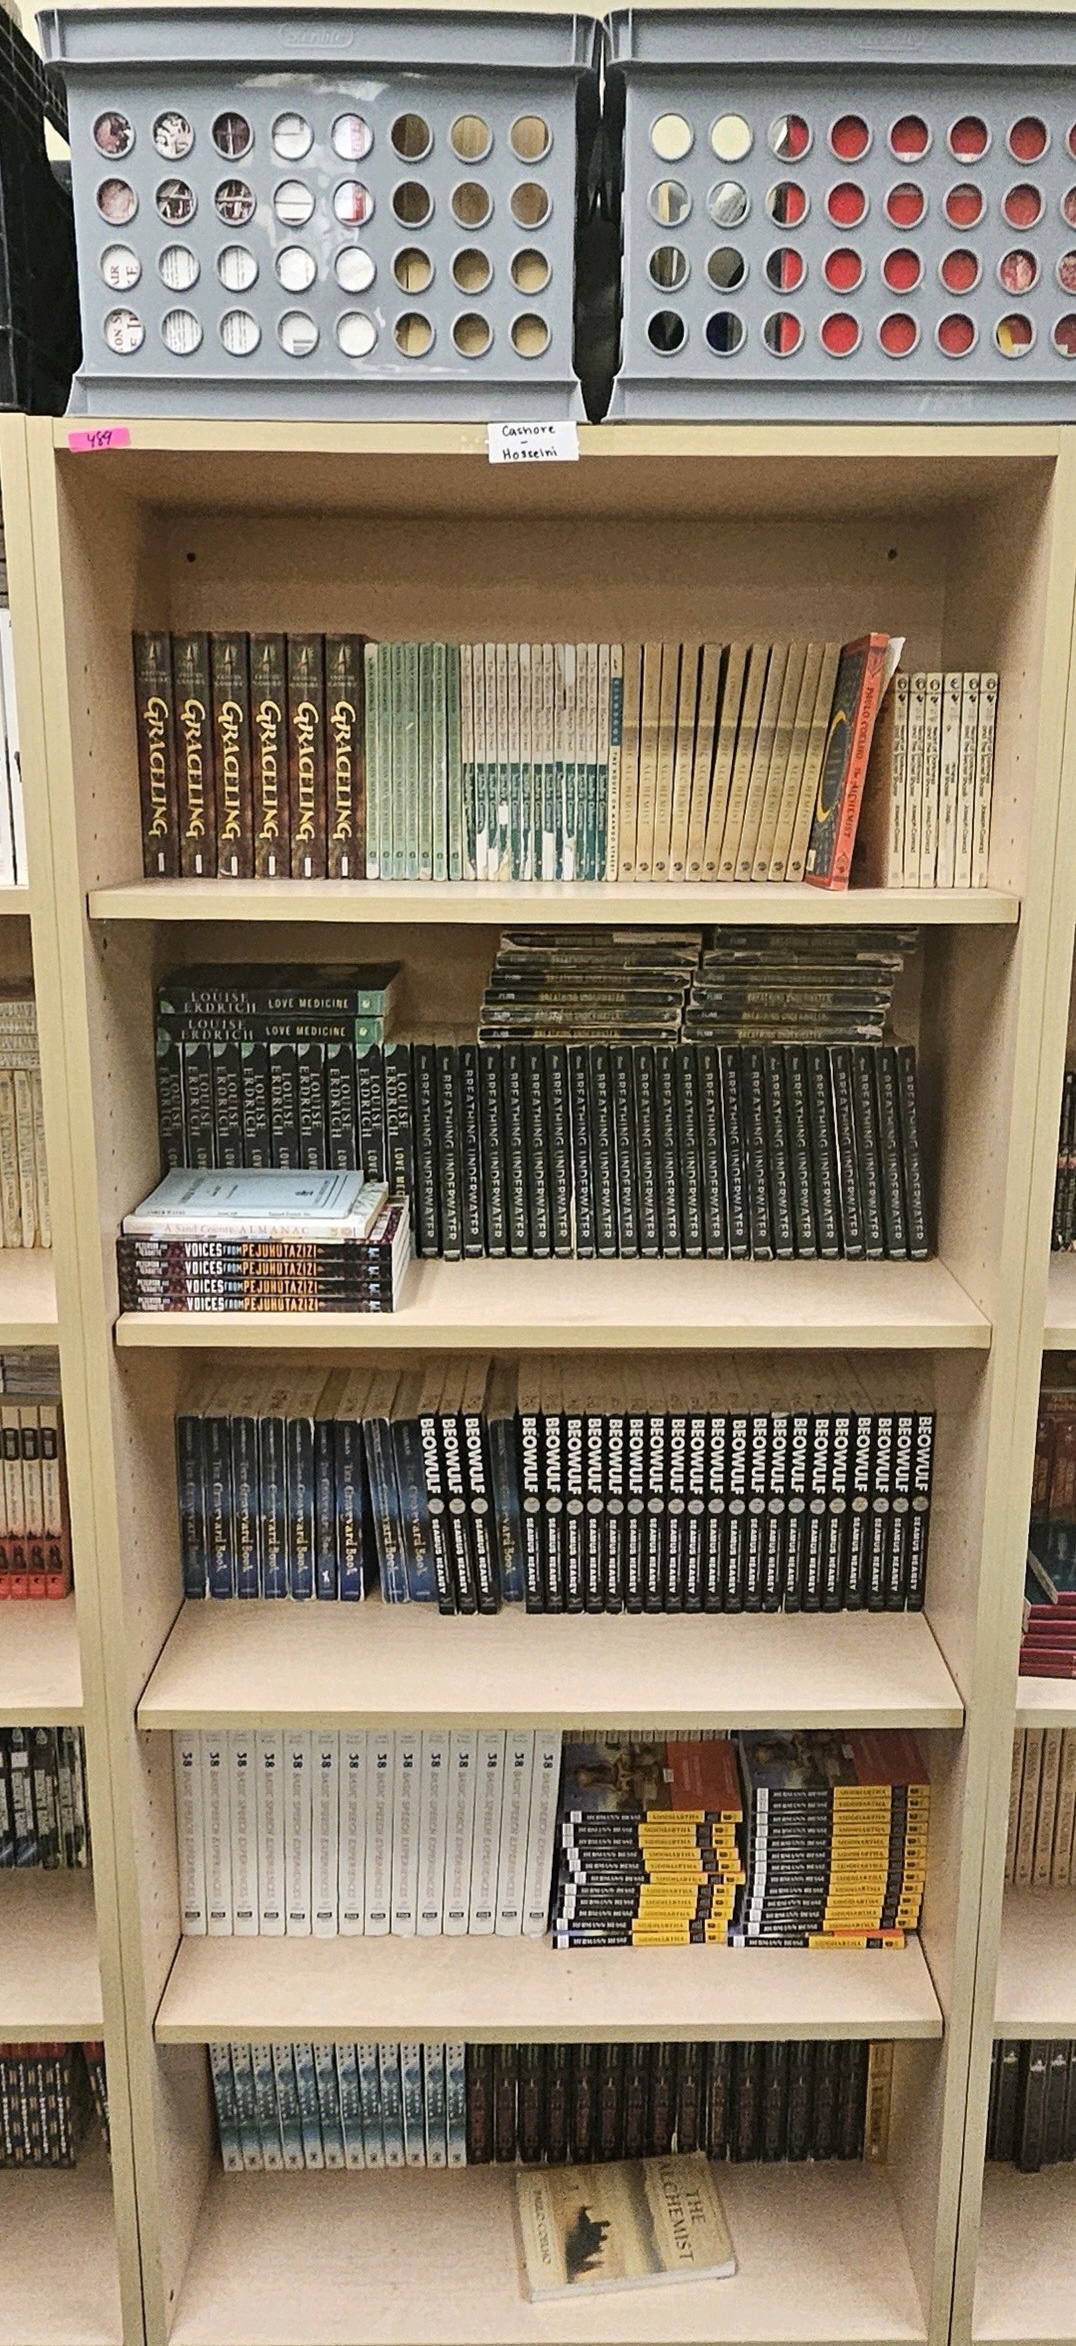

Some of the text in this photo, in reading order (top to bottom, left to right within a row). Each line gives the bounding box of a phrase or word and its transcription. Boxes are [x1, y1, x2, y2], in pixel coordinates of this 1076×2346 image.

[502, 425, 556, 437] Cashore
[144, 697, 168, 838] GRACELING
[181, 699, 205, 838] GRACELING
[218, 701, 243, 841] GRACELING
[256, 701, 281, 841] GRACELING
[293, 702, 319, 841] GRACELING
[331, 701, 356, 841] GRACELING
[181, 1025, 346, 1040] ERDRICH LOVE MEDICINE
[184, 999, 348, 1014] ERDRICH LOVE MEDICINE
[188, 1019, 246, 1030] LOUISE
[191, 992, 248, 1003] LOUISE
[188, 1067, 200, 1136] ERDRICH
[200, 1074, 210, 1128] LOUISE
[217, 1067, 229, 1136] ERDRICH
[228, 1074, 238, 1128] LOUISE
[244, 1068, 256, 1137] ERDRICH
[255, 1075, 266, 1129] LOUISE
[272, 1066, 283, 1136] ERDRICH
[282, 1073, 293, 1128] LOUISE
[300, 1066, 311, 1136] ERDRICH
[310, 1074, 321, 1128] LOUISE
[330, 1069, 341, 1138] ERDRICH
[341, 1075, 351, 1130] LOUISE
[360, 1069, 377, 1173] ERDRICH LOVE
[370, 1075, 381, 1130] LOUISE
[386, 1066, 398, 1136] ERDRICH
[395, 1148, 405, 1171] LOVE
[397, 1073, 408, 1129] LOUISE
[424, 1152, 435, 1238] UNDERWATER
[445, 1153, 456, 1240] UNDERWATER
[555, 1151, 568, 1238] UNDERWATER
[600, 1152, 612, 1239] UNDERWATER
[644, 1152, 655, 1239] UNDERWATER
[731, 1149, 743, 1236] UNDERWATER
[865, 1152, 878, 1239] UNDERWATER
[185, 1243, 223, 1257] VOICES
[242, 1244, 317, 1257] PEJUHUTAZIZI
[185, 1261, 223, 1275] VOICES
[243, 1262, 317, 1276] PEJUHUTAZIZI
[186, 1280, 224, 1294] VOICES
[243, 1280, 318, 1294] PEJUHUTAZIZI
[186, 1297, 225, 1311] VOICES
[244, 1298, 318, 1311] PEJUHUTAZIZI
[421, 1418, 441, 1493] BEOWULF
[442, 1419, 463, 1493] BEOWULF
[465, 1418, 485, 1493] BEOWULF
[523, 1418, 538, 1493] BEOWULF
[546, 1418, 561, 1493] BEOWULF
[568, 1420, 582, 1494] BEOWULF
[609, 1419, 622, 1494] BEOWULF
[629, 1419, 643, 1494] BEOWULF
[649, 1418, 664, 1494] BEOWULF
[690, 1419, 705, 1494] BEOWULF
[710, 1418, 725, 1494] BEOWULF
[731, 1420, 746, 1494] BEOWULF
[770, 1418, 787, 1494] BEOWULF
[791, 1418, 807, 1493] BEOWULF
[812, 1419, 829, 1494] BEOWULF
[855, 1418, 871, 1492] BEOWULF
[876, 1418, 892, 1493] BEOWULF
[896, 1418, 912, 1492] BEOWULF
[915, 1417, 932, 1491] BEOWULF
[242, 1546, 253, 1573] Book
[346, 1547, 357, 1576] Book
[182, 1752, 192, 1767] 38
[210, 1752, 220, 1767] 38
[265, 1753, 275, 1768] 38
[321, 1753, 331, 1768] 38
[430, 1753, 441, 1768] 38
[544, 1753, 553, 1768] 38
[658, 2161, 694, 2261] ALCHEMIST
[686, 2190, 705, 2224] THE
